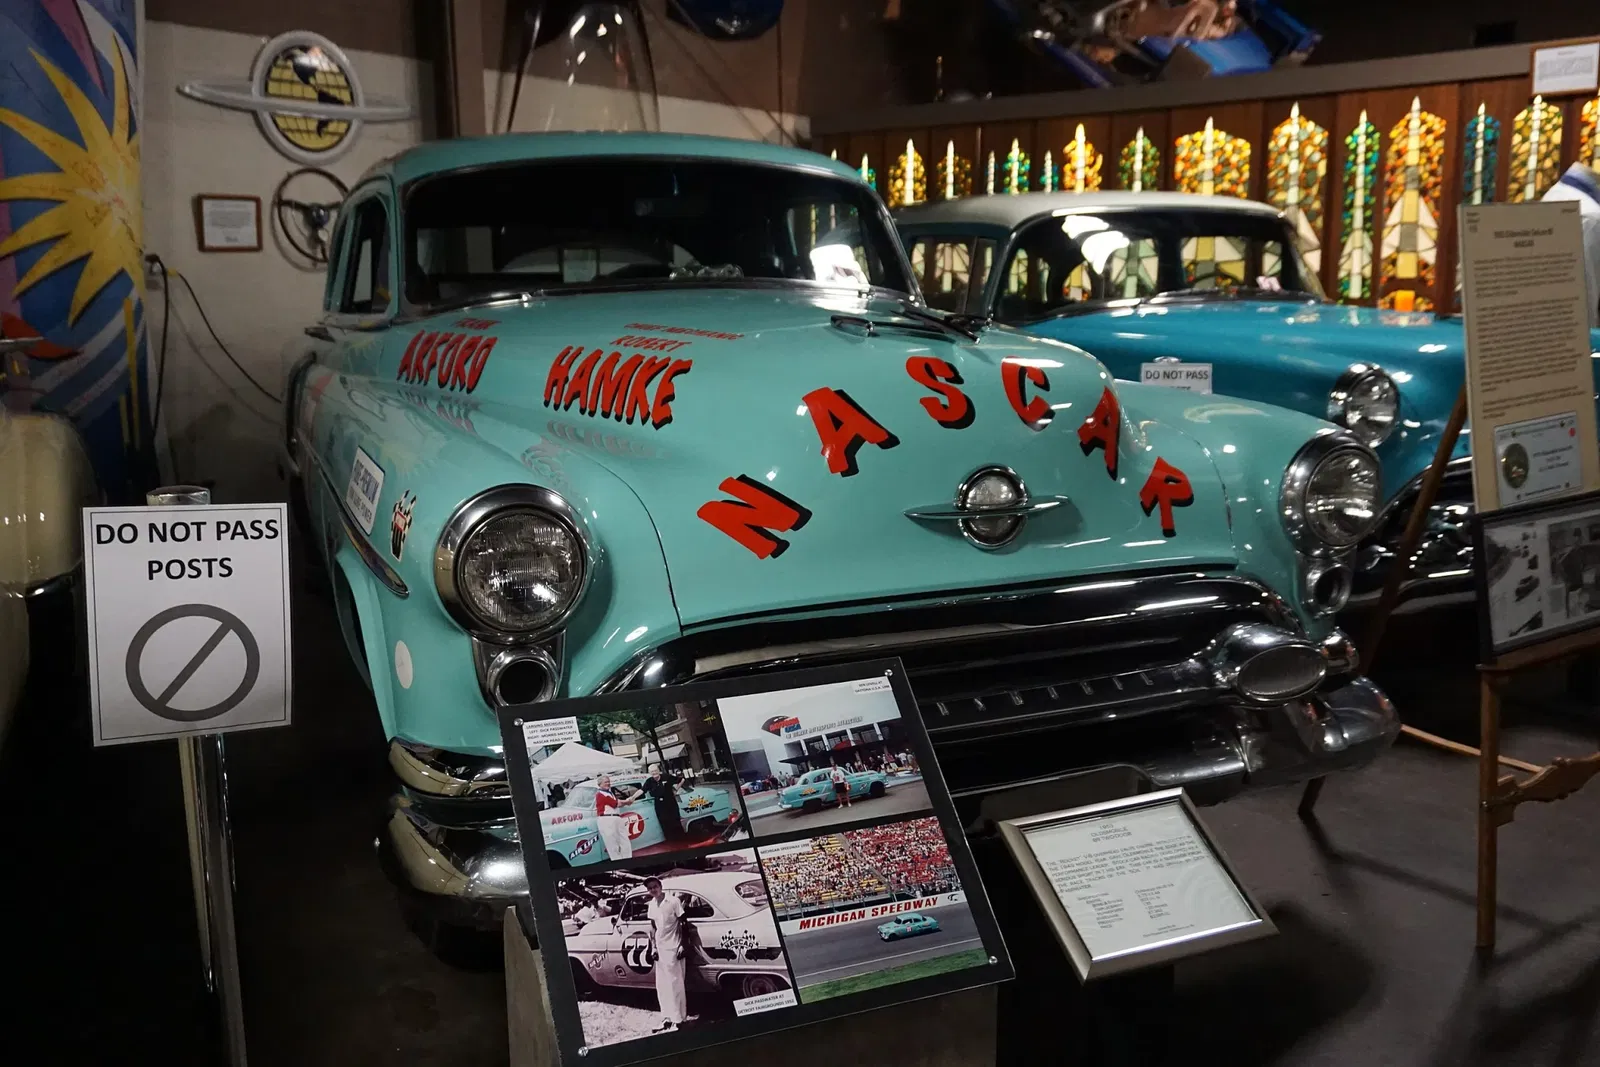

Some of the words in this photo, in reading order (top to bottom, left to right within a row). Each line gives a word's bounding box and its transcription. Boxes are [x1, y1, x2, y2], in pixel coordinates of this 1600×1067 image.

[609, 335, 692, 352] ROBERT
[396, 330, 498, 394] ARFORD
[1145, 370, 1160, 380] DO
[1162, 370, 1183, 380] NOT
[1186, 370, 1209, 380] PASS
[544, 345, 692, 430] HAMKE
[697, 356, 1194, 559] NASCAR
[96, 523, 138, 544] DO
[148, 521, 207, 543] NOT
[216, 519, 279, 541] PASS
[148, 557, 234, 581] POSTS
[551, 813, 584, 825] ARFORD
[800, 909, 866, 930] MICHIGAN
[872, 897, 938, 918] SPEEDWAY
[624, 938, 652, 967] 77
[724, 939, 754, 950] NASCAR
[755, 996, 778, 1005] PASSWATER
